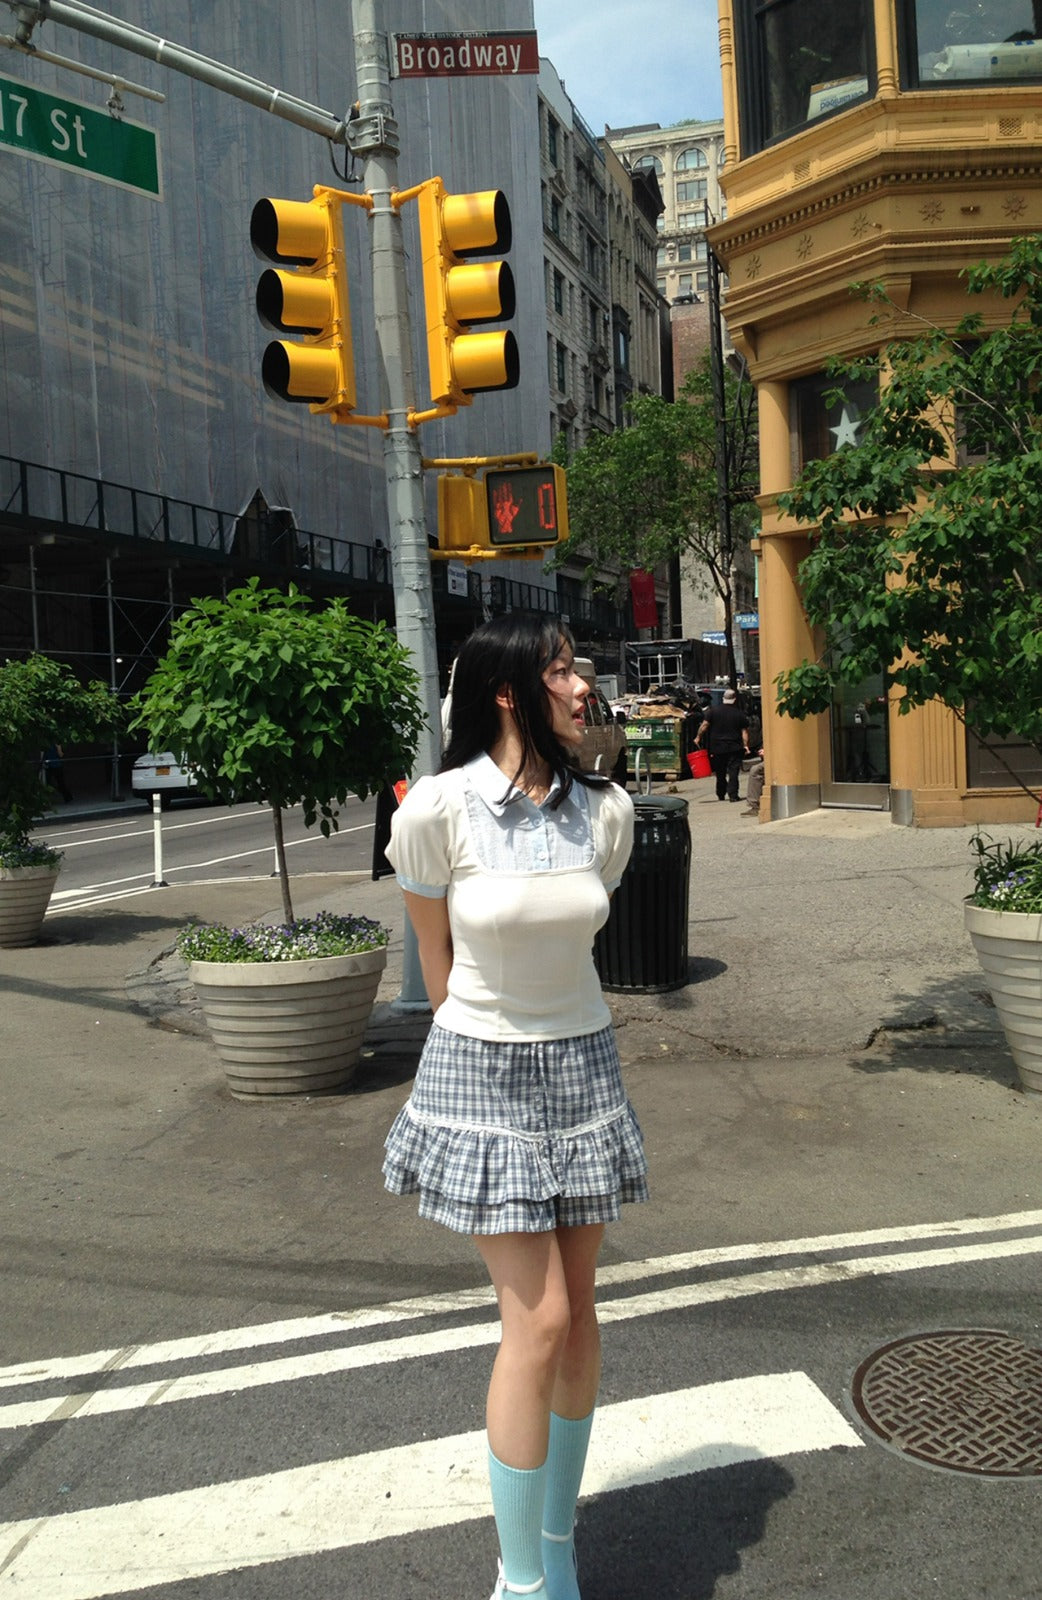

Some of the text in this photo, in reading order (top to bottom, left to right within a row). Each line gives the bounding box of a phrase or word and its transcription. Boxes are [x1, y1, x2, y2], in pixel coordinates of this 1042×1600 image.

[400, 39, 521, 73] Broadway
[50, 108, 88, 158] St
[735, 614, 758, 623] Park
